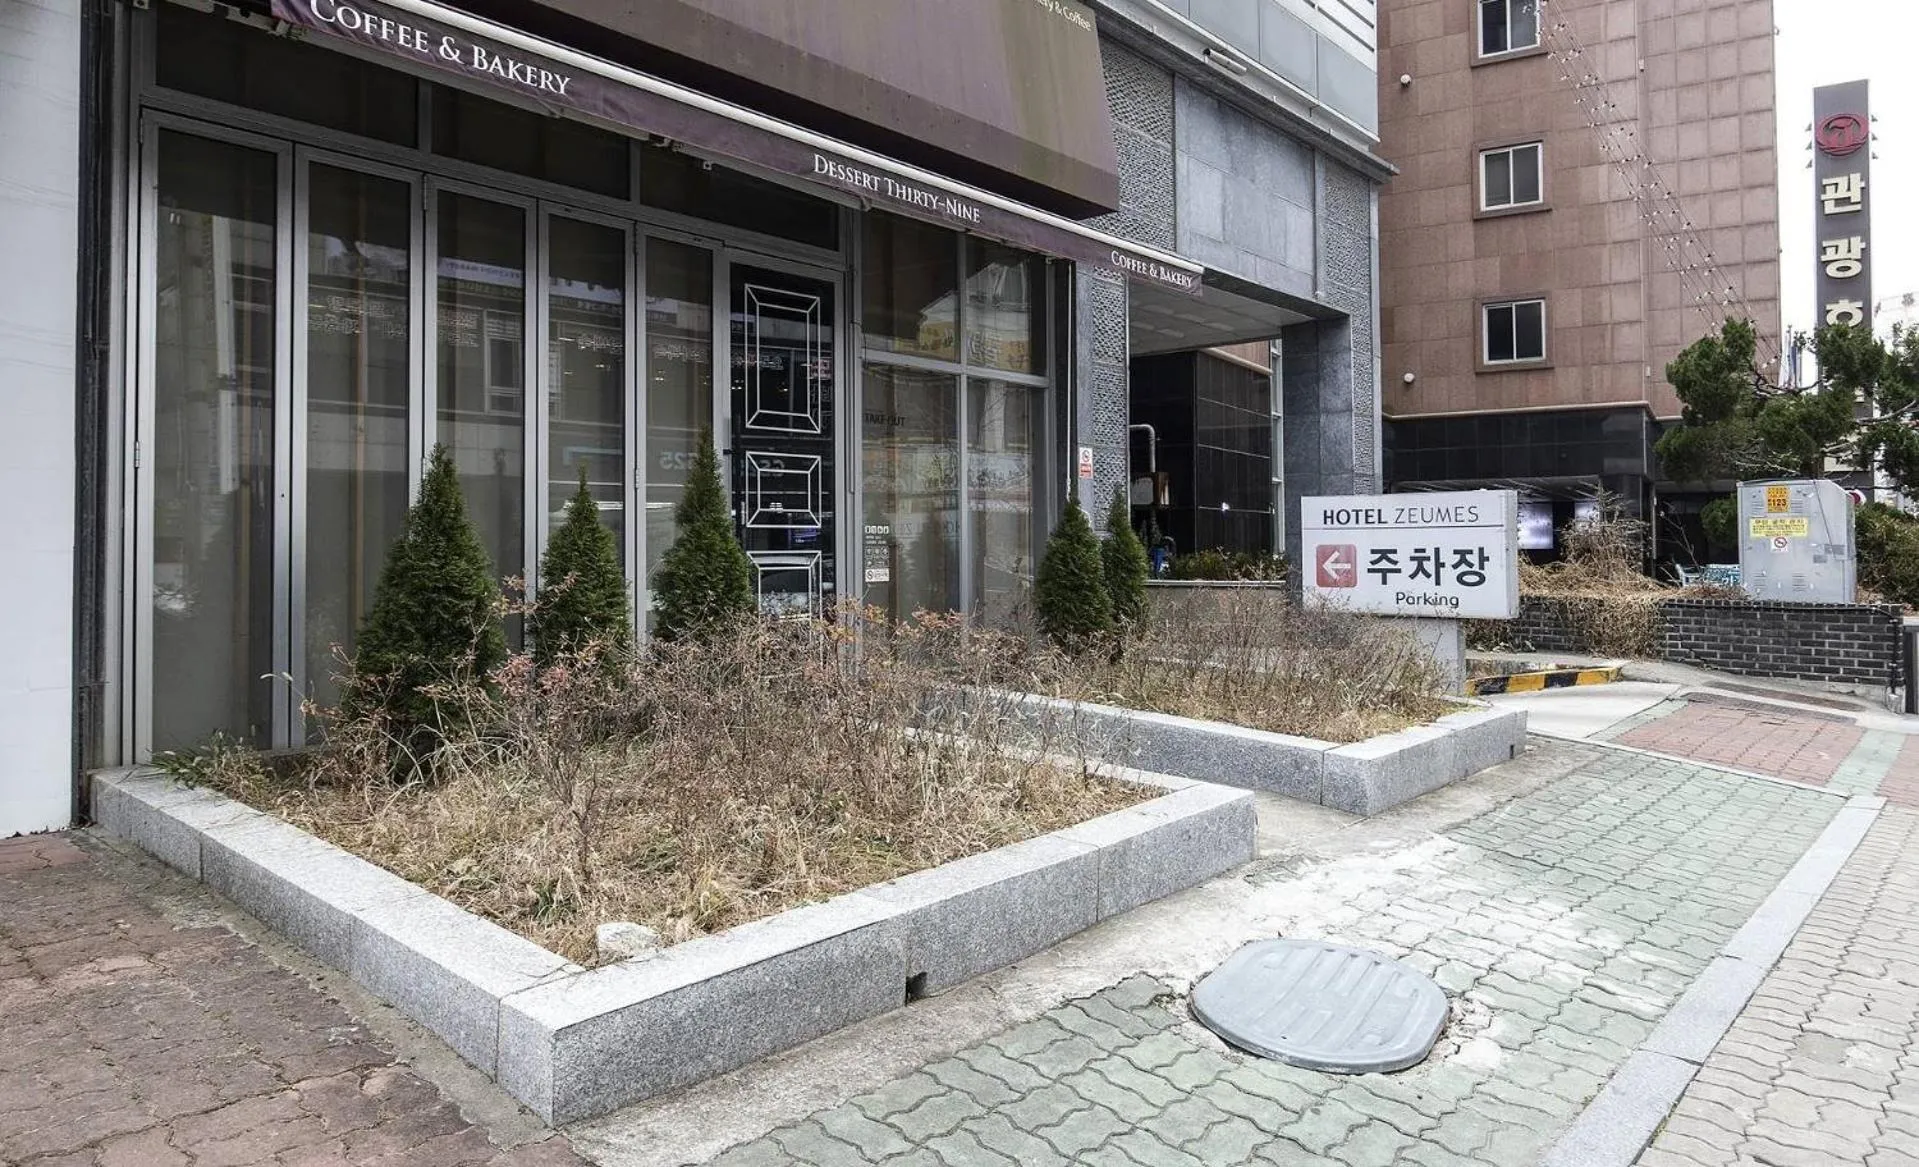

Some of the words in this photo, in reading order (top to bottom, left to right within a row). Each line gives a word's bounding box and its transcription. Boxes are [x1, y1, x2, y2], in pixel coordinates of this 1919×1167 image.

[1063, 6, 1092, 31] Coffee
[311, 0, 429, 53] COFFEE
[439, 36, 463, 64] &
[472, 45, 571, 95] BAKERY
[814, 154, 880, 192] DESSERT
[884, 177, 981, 223] THIRTY-NINE
[1111, 250, 1147, 275] COFFEE
[1149, 264, 1158, 279] &
[1160, 266, 1192, 288] BAKERY
[1323, 508, 1388, 526] HOTEL
[1394, 506, 1479, 524] ZEUMES
[1366, 546, 1490, 587] 주차장
[1395, 592, 1459, 609] Parking
